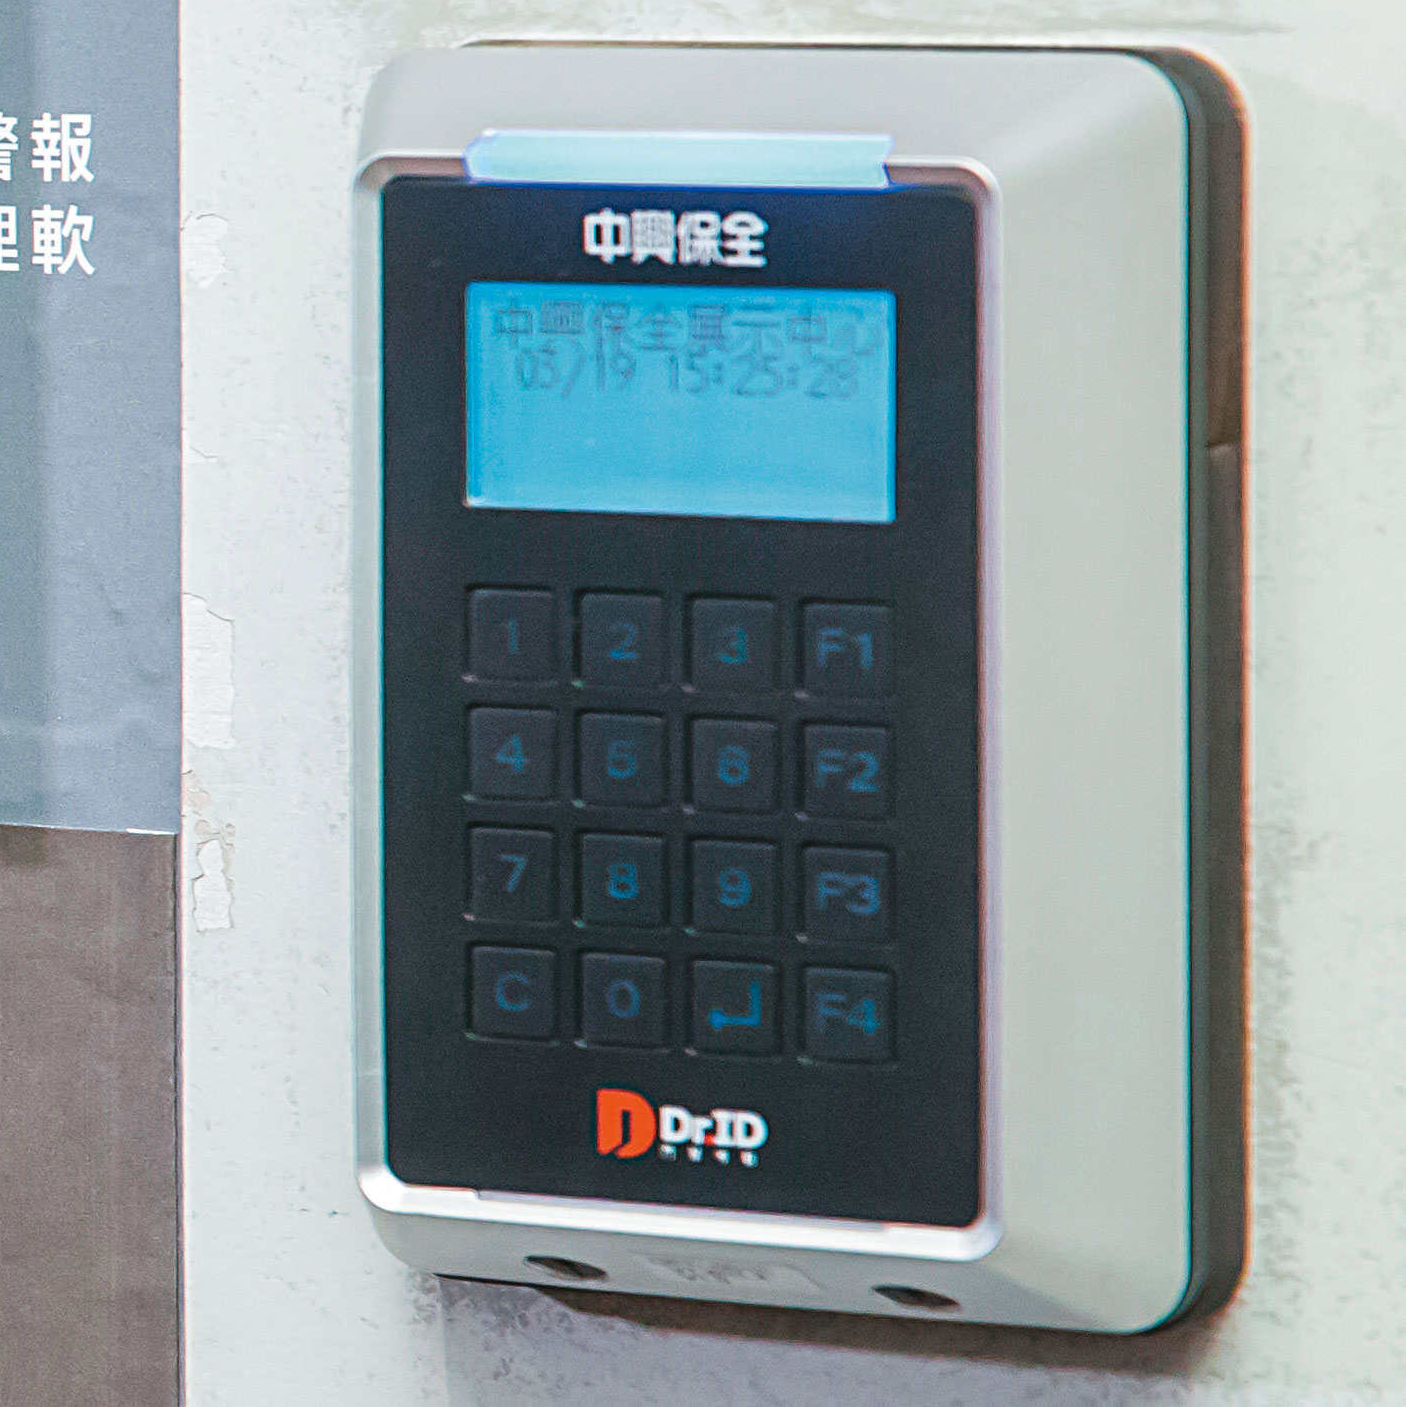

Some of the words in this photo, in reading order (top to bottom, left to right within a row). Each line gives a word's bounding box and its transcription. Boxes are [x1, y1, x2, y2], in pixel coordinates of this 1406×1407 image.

[502, 620, 520, 655] 1
[608, 624, 639, 660] 2
[718, 628, 747, 664] 3
[817, 627, 874, 668] F1
[496, 736, 529, 773] 4
[607, 741, 636, 778] 5
[718, 746, 749, 784] 6
[816, 751, 879, 792] F2
[500, 855, 527, 893] 7
[608, 862, 639, 900] 8
[718, 871, 750, 908] 9
[817, 874, 881, 915] F3
[496, 974, 530, 1012] C
[608, 982, 640, 1019] 0
[818, 997, 879, 1035] F4
